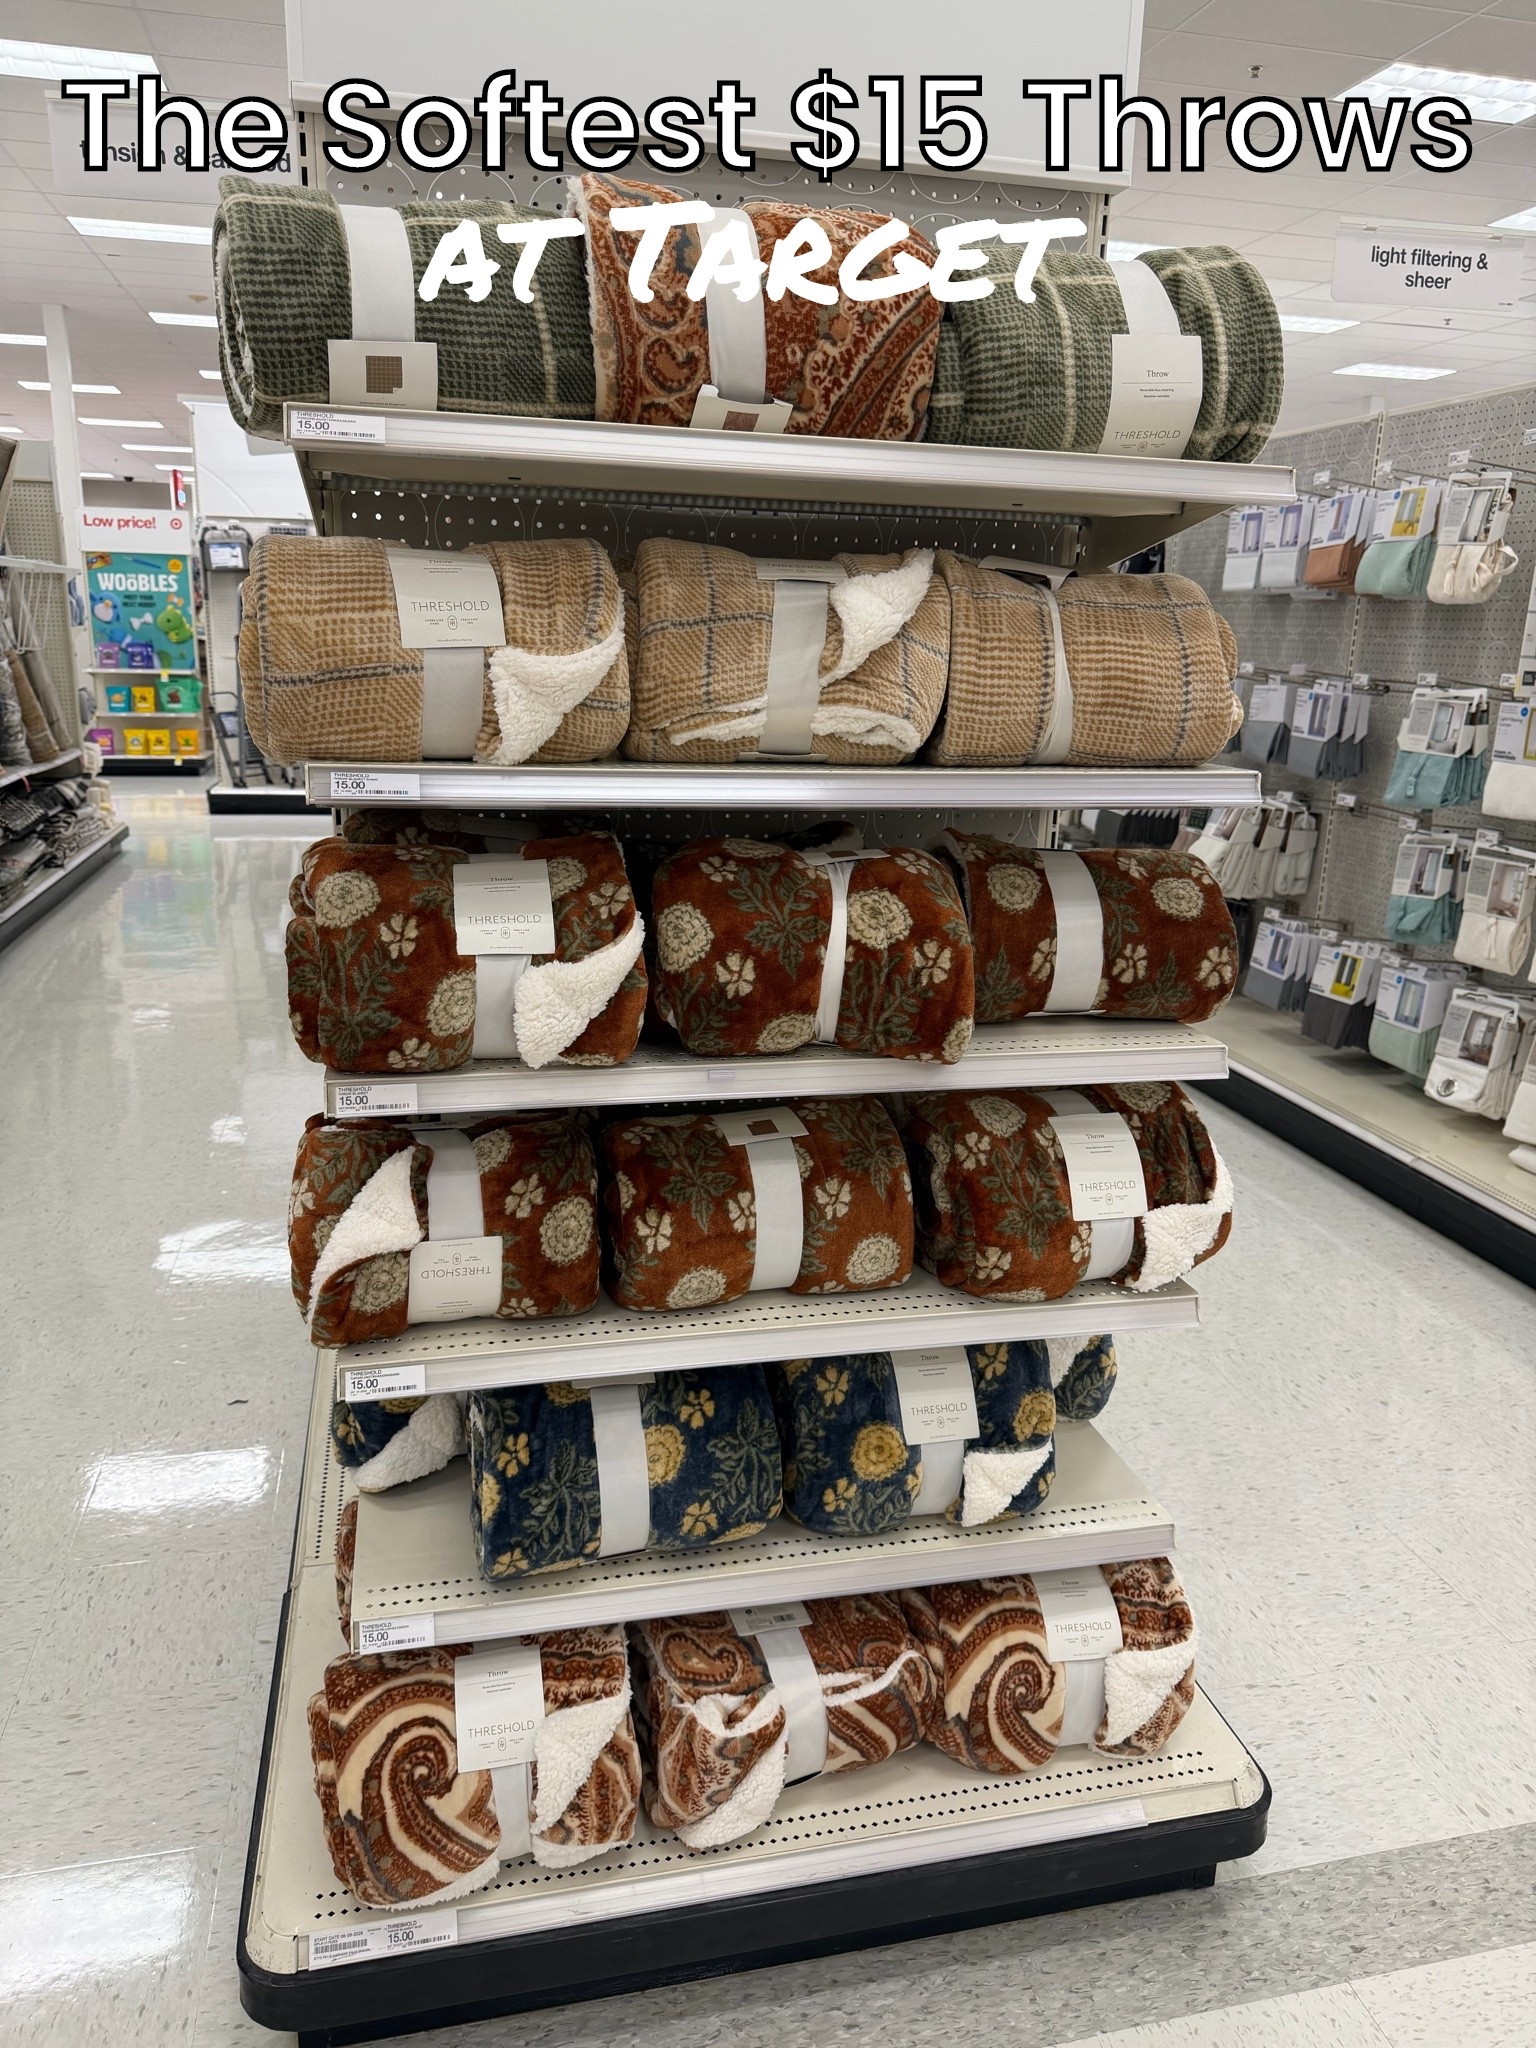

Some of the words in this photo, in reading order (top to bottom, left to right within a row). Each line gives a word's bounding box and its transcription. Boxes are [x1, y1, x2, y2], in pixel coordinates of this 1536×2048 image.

[1371, 245, 1407, 268] light
[1411, 248, 1472, 273] filtering
[1476, 252, 1489, 270] &
[1405, 271, 1452, 290] sheer
[1146, 370, 1170, 378] Throw
[297, 420, 330, 430] 15.00
[1114, 430, 1181, 440] THRESHOLD
[83, 514, 113, 527] Low
[117, 516, 157, 530] price!
[411, 600, 490, 612] THRESHOLD
[335, 780, 365, 789] 15.00
[467, 914, 542, 924] THRESHOLD
[339, 1095, 369, 1106] 15.00
[1079, 1180, 1136, 1193] THRESHOLD
[421, 1265, 491, 1279] THRESHOLD
[351, 1378, 379, 1390] 15.00
[910, 1402, 968, 1416] THRESHOLD
[1054, 1621, 1112, 1634] THRESHOLD
[362, 1632, 389, 1643] 15.00
[487, 1670, 510, 1678] Throw
[468, 1720, 535, 1739] THRESHOLD
[388, 1930, 414, 1943] 15.00
